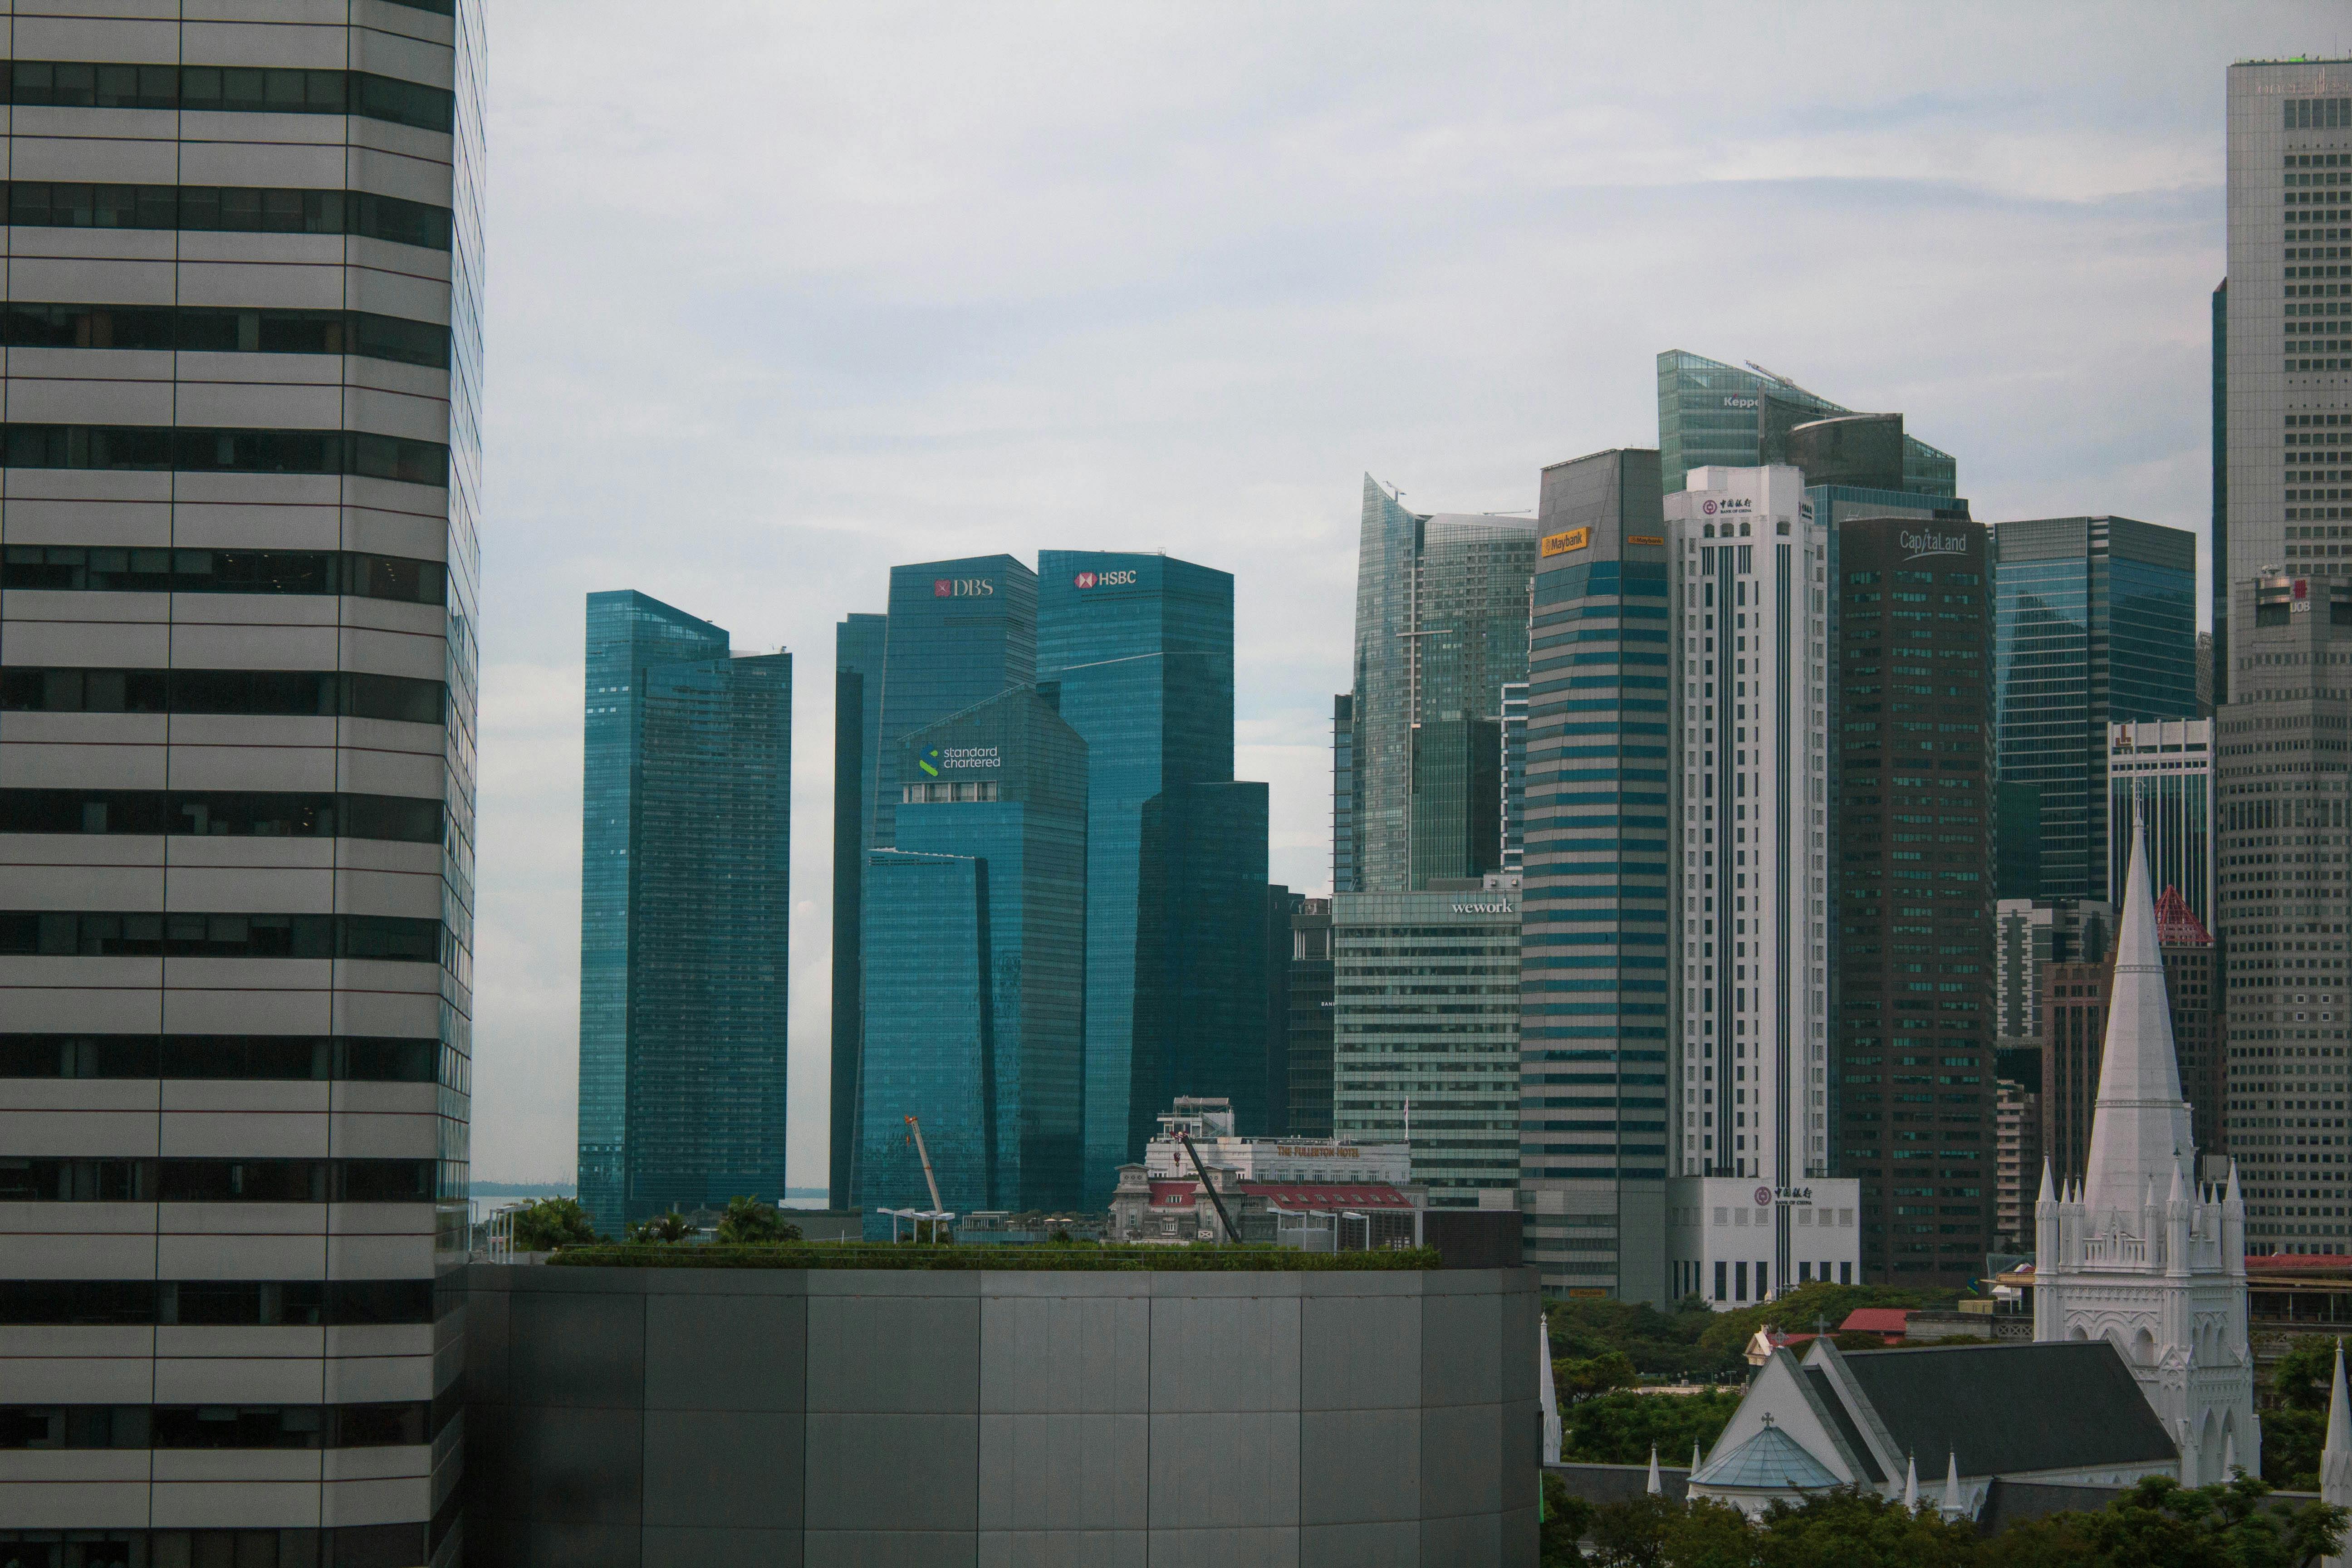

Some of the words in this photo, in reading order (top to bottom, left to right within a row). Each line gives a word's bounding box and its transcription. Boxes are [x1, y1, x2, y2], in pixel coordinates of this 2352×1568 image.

[1552, 531, 1582, 551] Maybank
[1900, 528, 1966, 554] CapitaLand
[1099, 570, 1137, 585] HSBC
[954, 578, 993, 596] DBS
[2290, 601, 2310, 613] UOB
[944, 746, 997, 757] standard
[944, 757, 1001, 768] chartered
[1452, 898, 1514, 913] wework
[1277, 1145, 1292, 1156] THE
[1294, 1146, 1334, 1157] FULLERTON
[1337, 1147, 1360, 1157] HOTEL
